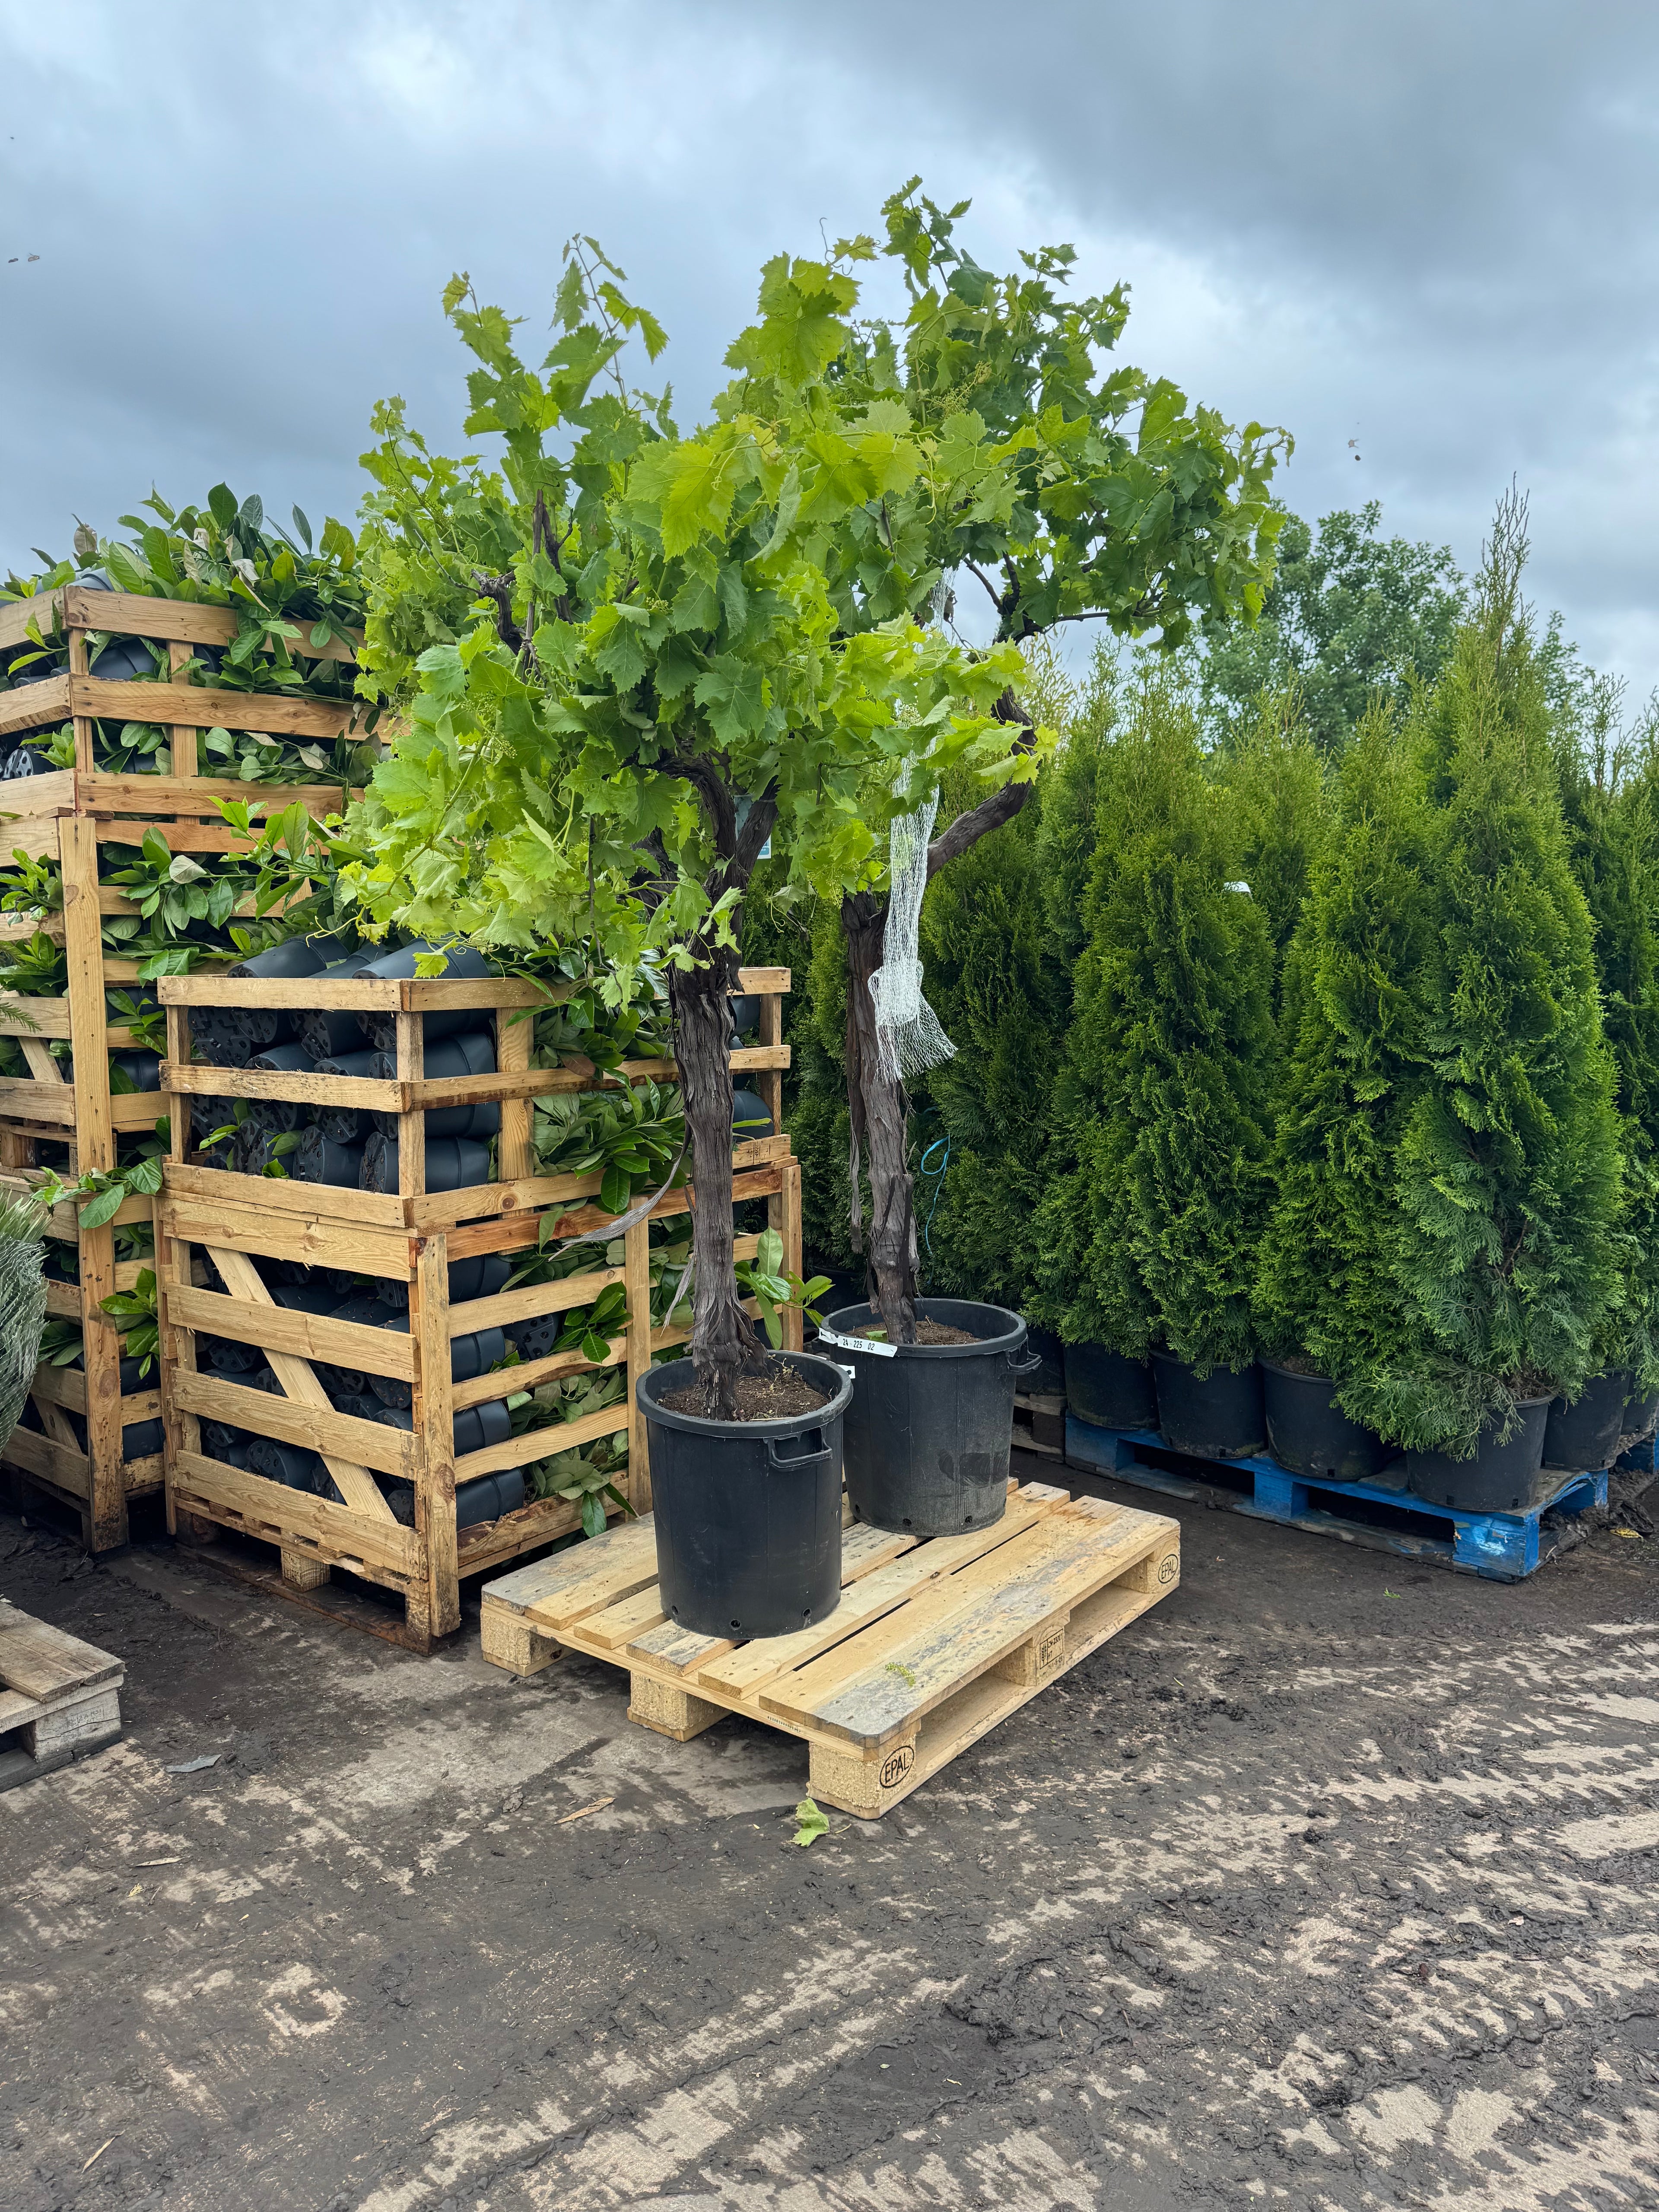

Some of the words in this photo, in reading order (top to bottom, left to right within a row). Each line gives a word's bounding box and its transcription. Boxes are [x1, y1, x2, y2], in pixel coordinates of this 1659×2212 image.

[868, 1342, 875, 1351] 02
[1161, 1559, 1176, 1580] EPAL
[884, 1752, 909, 1784] EPAL
